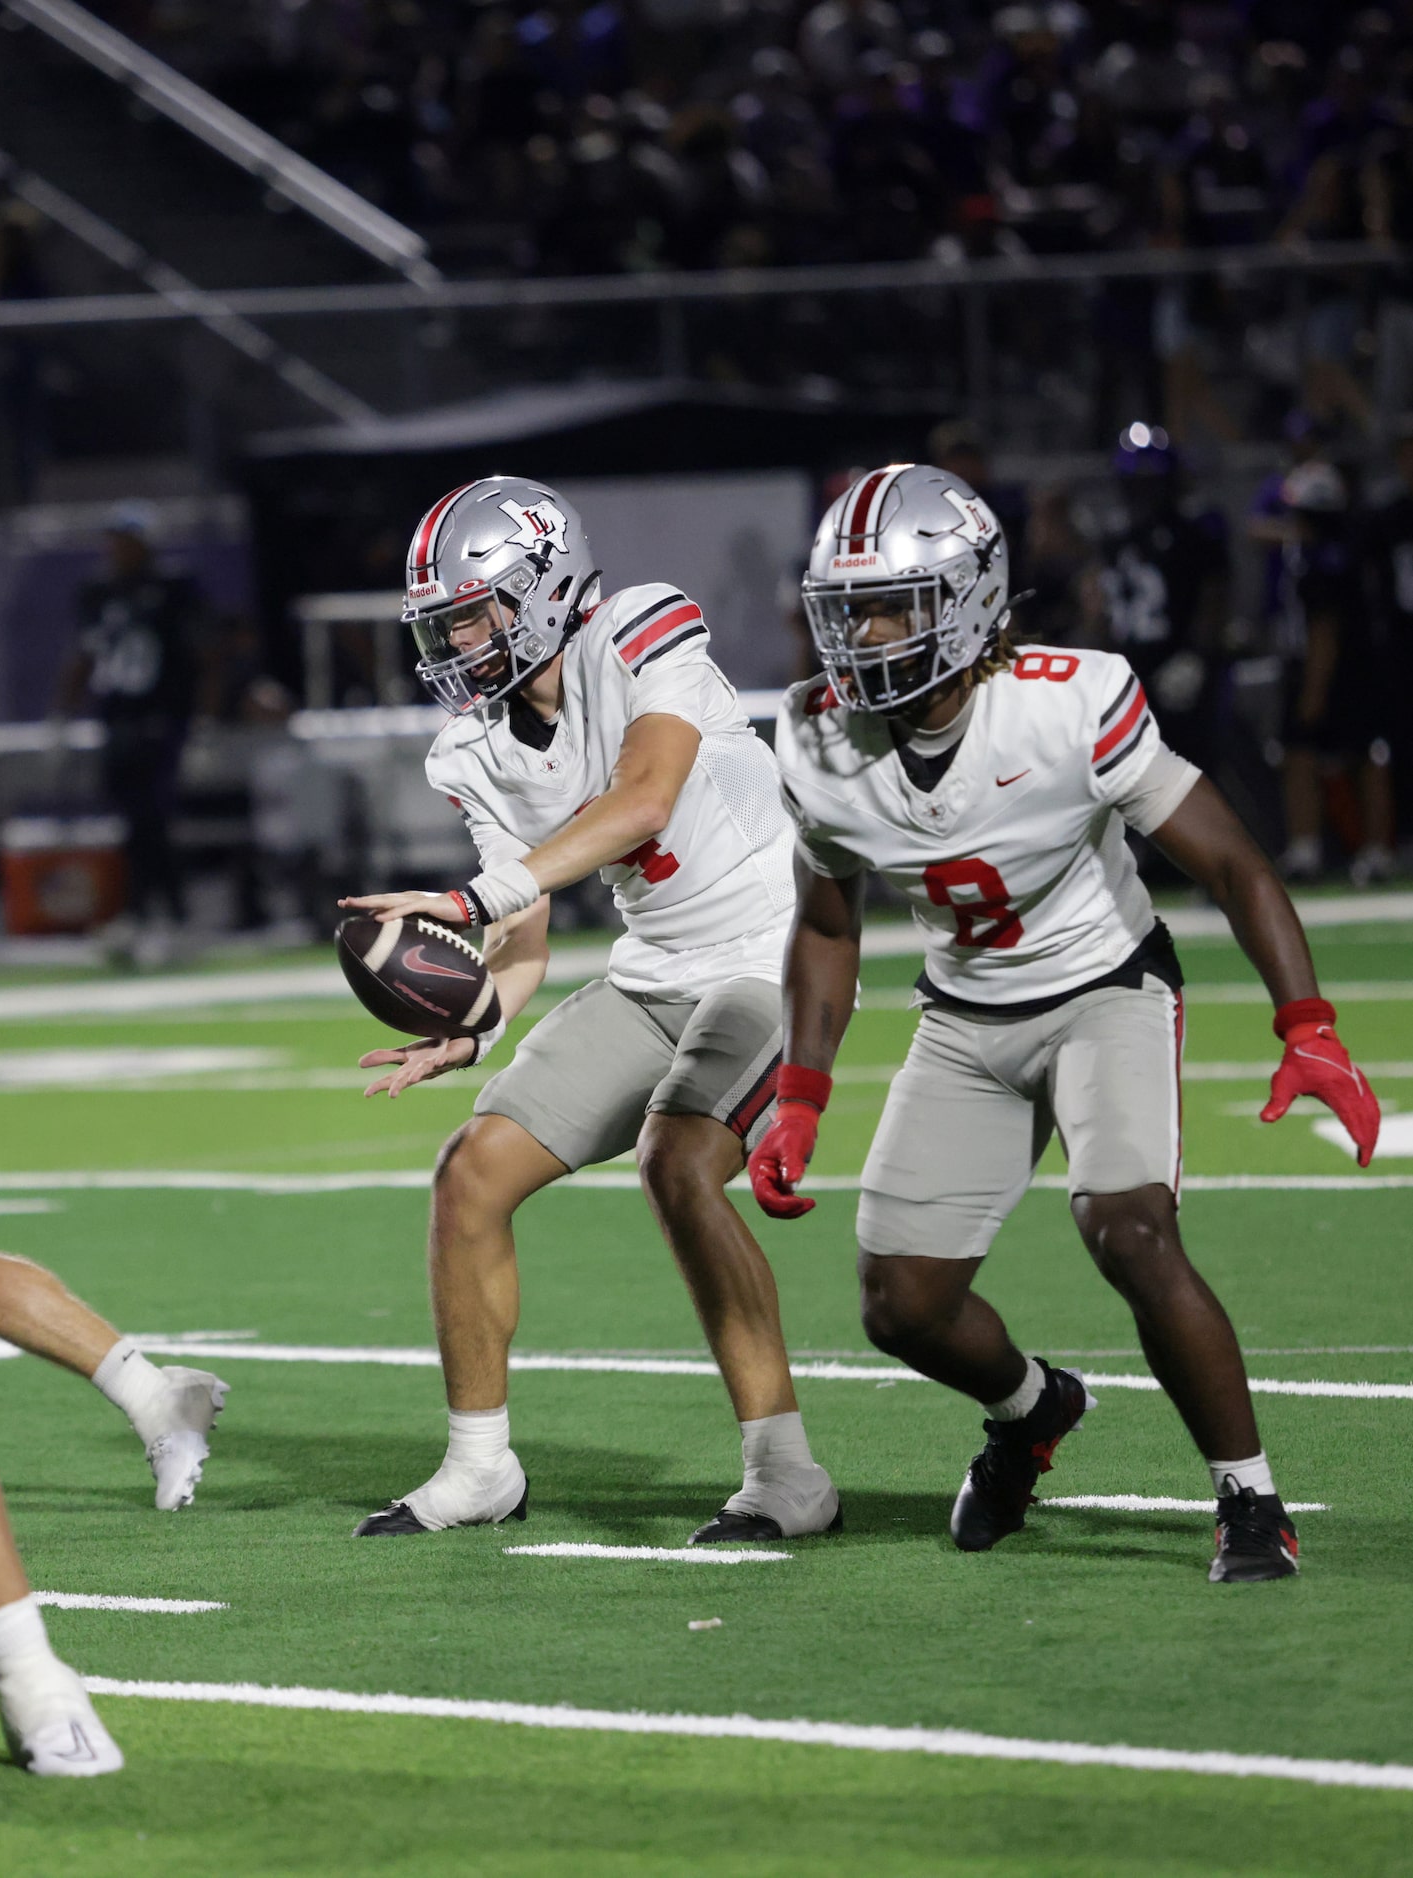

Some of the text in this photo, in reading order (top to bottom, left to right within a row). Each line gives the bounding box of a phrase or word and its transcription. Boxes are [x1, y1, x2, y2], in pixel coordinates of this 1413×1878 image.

[833, 554, 877, 569] Riddell
[408, 583, 437, 599] Riddell
[1013, 653, 1081, 682] 8
[921, 857, 1024, 948] 8
